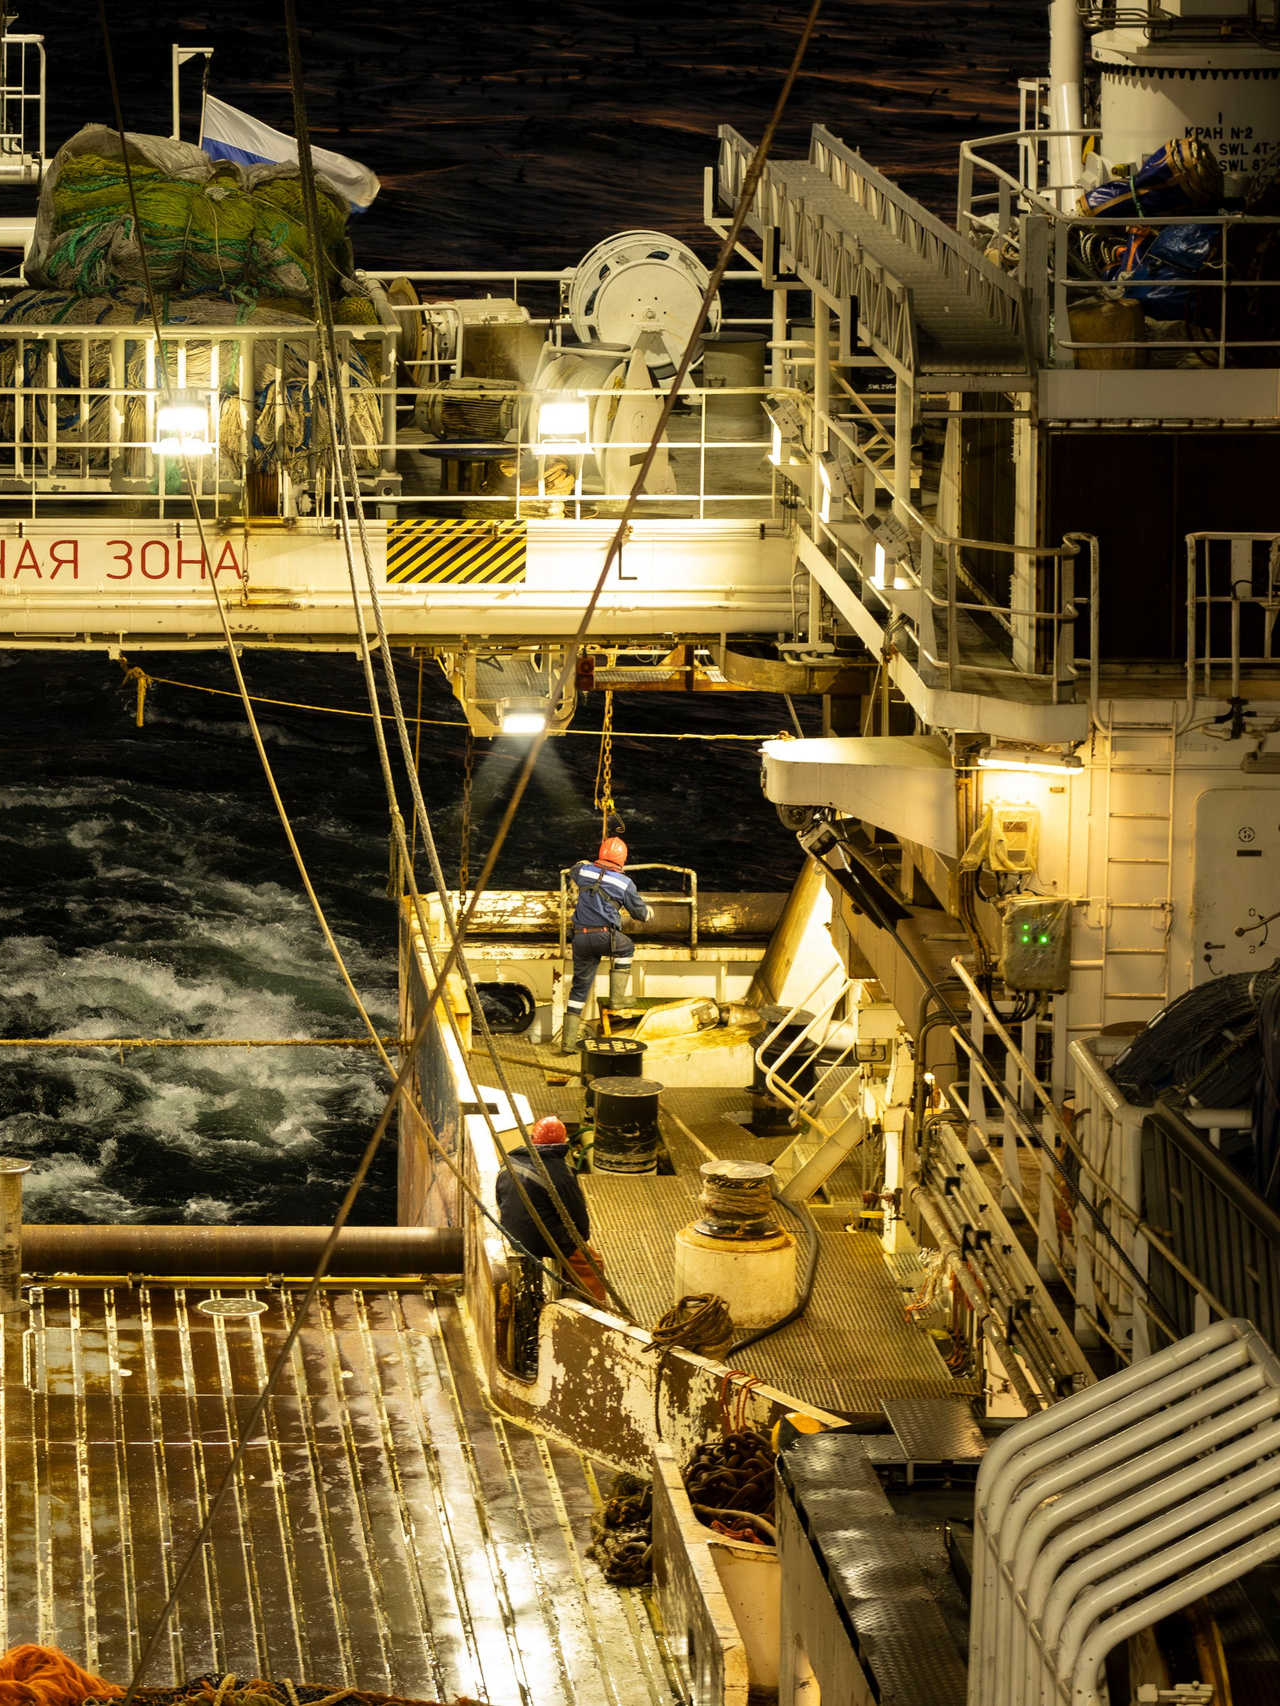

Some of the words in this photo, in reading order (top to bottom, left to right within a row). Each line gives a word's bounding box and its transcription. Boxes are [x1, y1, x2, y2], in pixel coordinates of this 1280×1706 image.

[1219, 143, 1249, 155] SWL
[1218, 160, 1249, 172] SWL
[106, 540, 243, 579] ЗОНА
[618, 541, 638, 580] L
